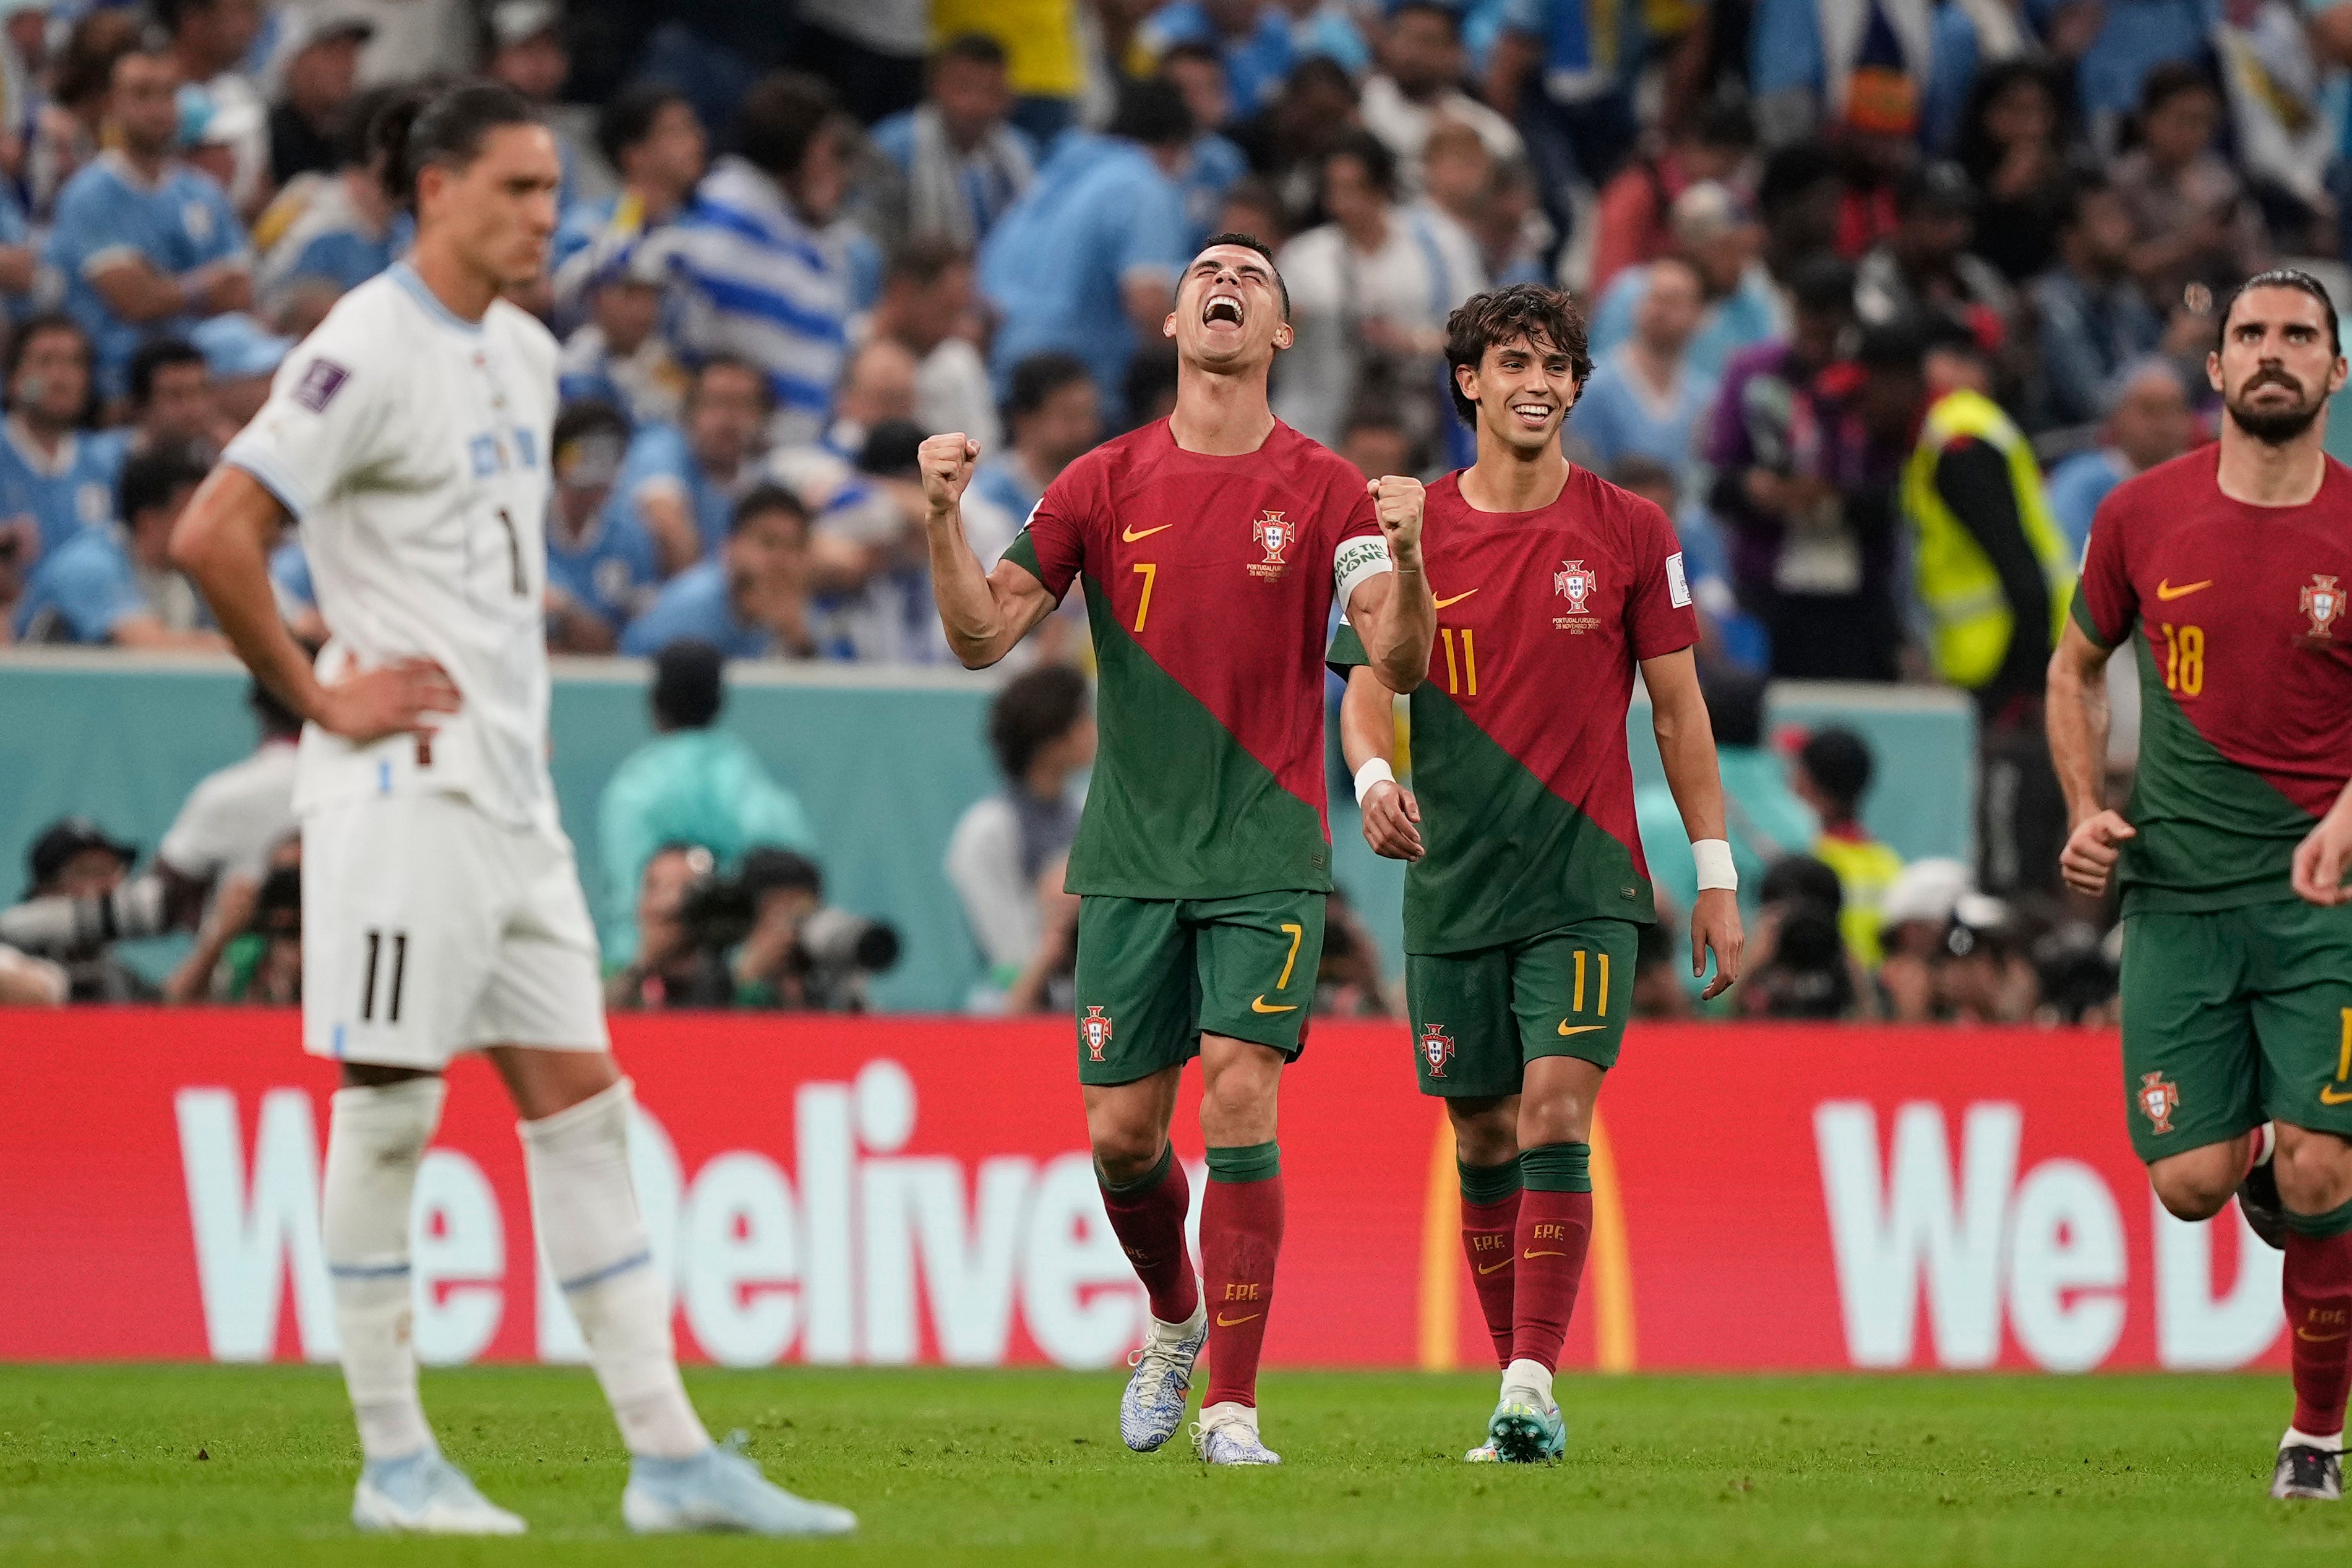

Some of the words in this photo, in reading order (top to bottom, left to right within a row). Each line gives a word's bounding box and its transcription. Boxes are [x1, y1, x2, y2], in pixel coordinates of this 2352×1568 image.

[1359, 544, 1384, 552] TH
[1133, 563, 1156, 632] 7
[1441, 628, 1477, 696] 11
[2162, 622, 2205, 696] 18
[361, 929, 408, 1024] 11
[1276, 924, 1302, 990] 7
[1573, 950, 1608, 1017] 11
[176, 1088, 504, 1367] We
[537, 1059, 1208, 1369] elive
[1814, 1101, 2127, 1373] We
